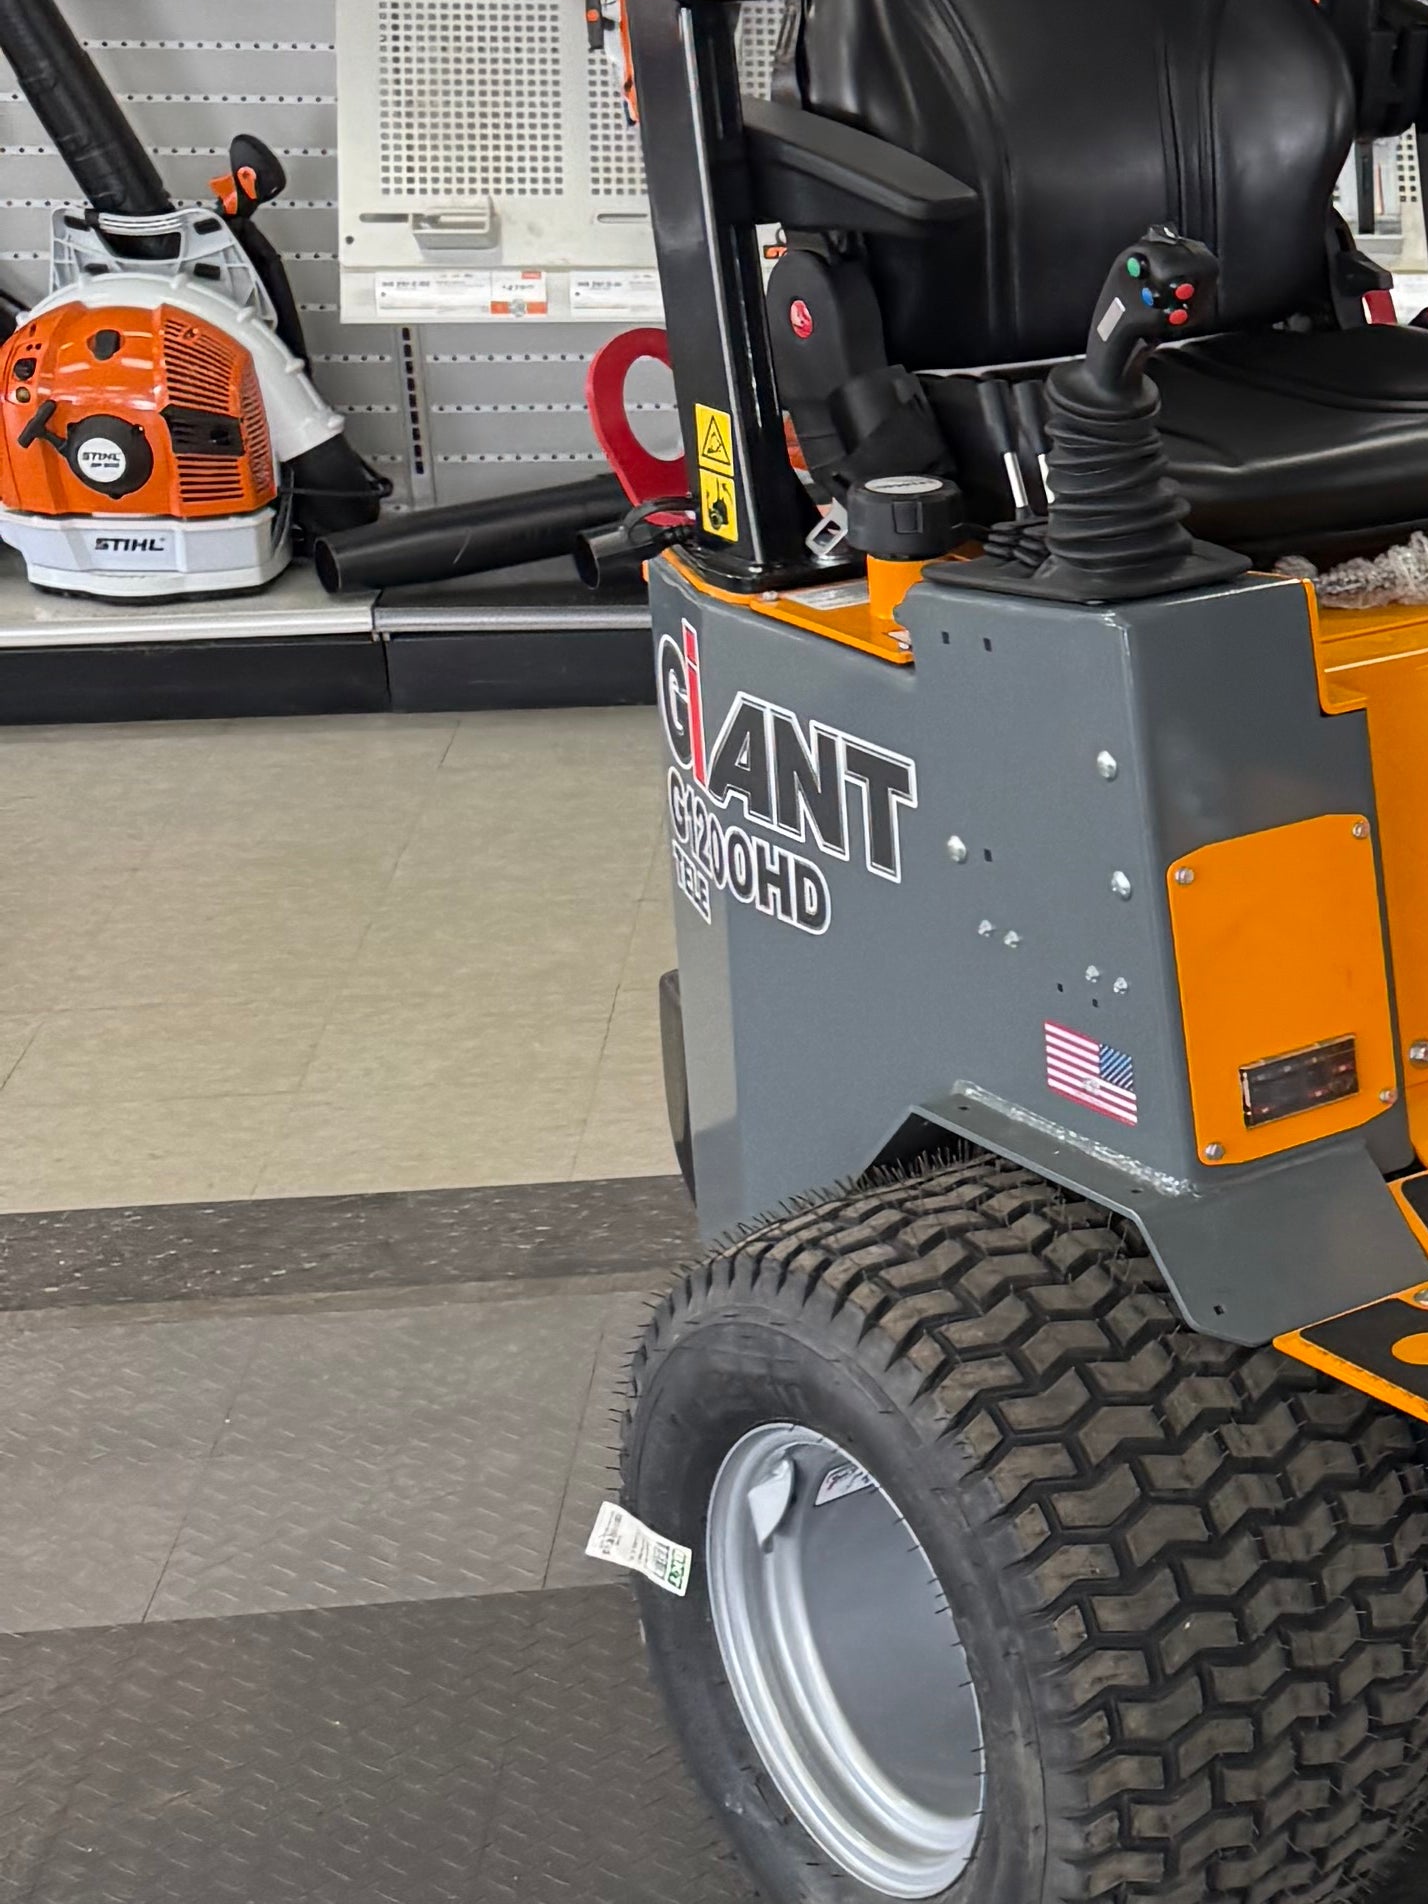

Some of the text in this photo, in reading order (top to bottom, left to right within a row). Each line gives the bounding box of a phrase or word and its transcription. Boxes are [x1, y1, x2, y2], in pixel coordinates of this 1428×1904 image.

[82, 452, 121, 462] STIHL
[95, 538, 165, 552] STIHL
[668, 766, 832, 936] G1200HD
